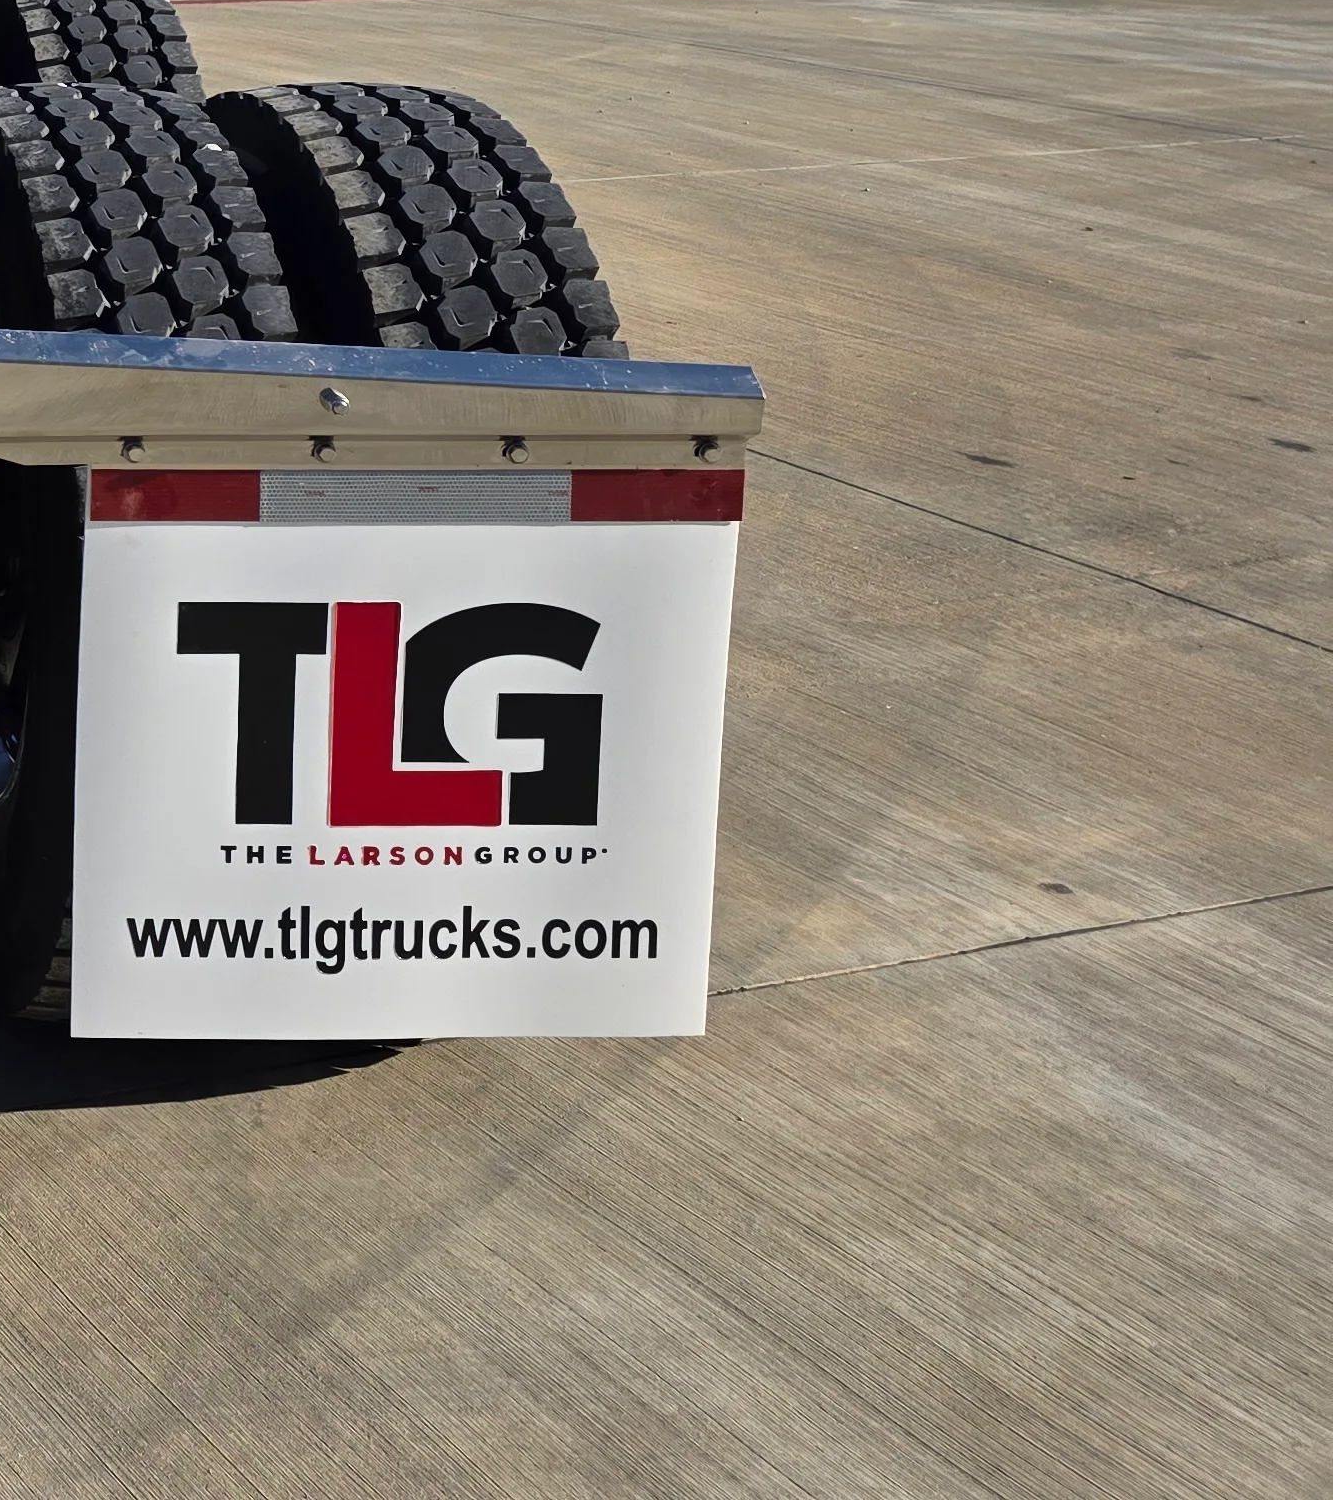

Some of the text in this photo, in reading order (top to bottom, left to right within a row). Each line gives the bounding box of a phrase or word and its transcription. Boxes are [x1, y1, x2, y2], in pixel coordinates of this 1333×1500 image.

[176, 601, 604, 826] TLG
[220, 845, 598, 866] THE LARSON GROUP
[126, 905, 658, 975] www.tlgtrucks.com
